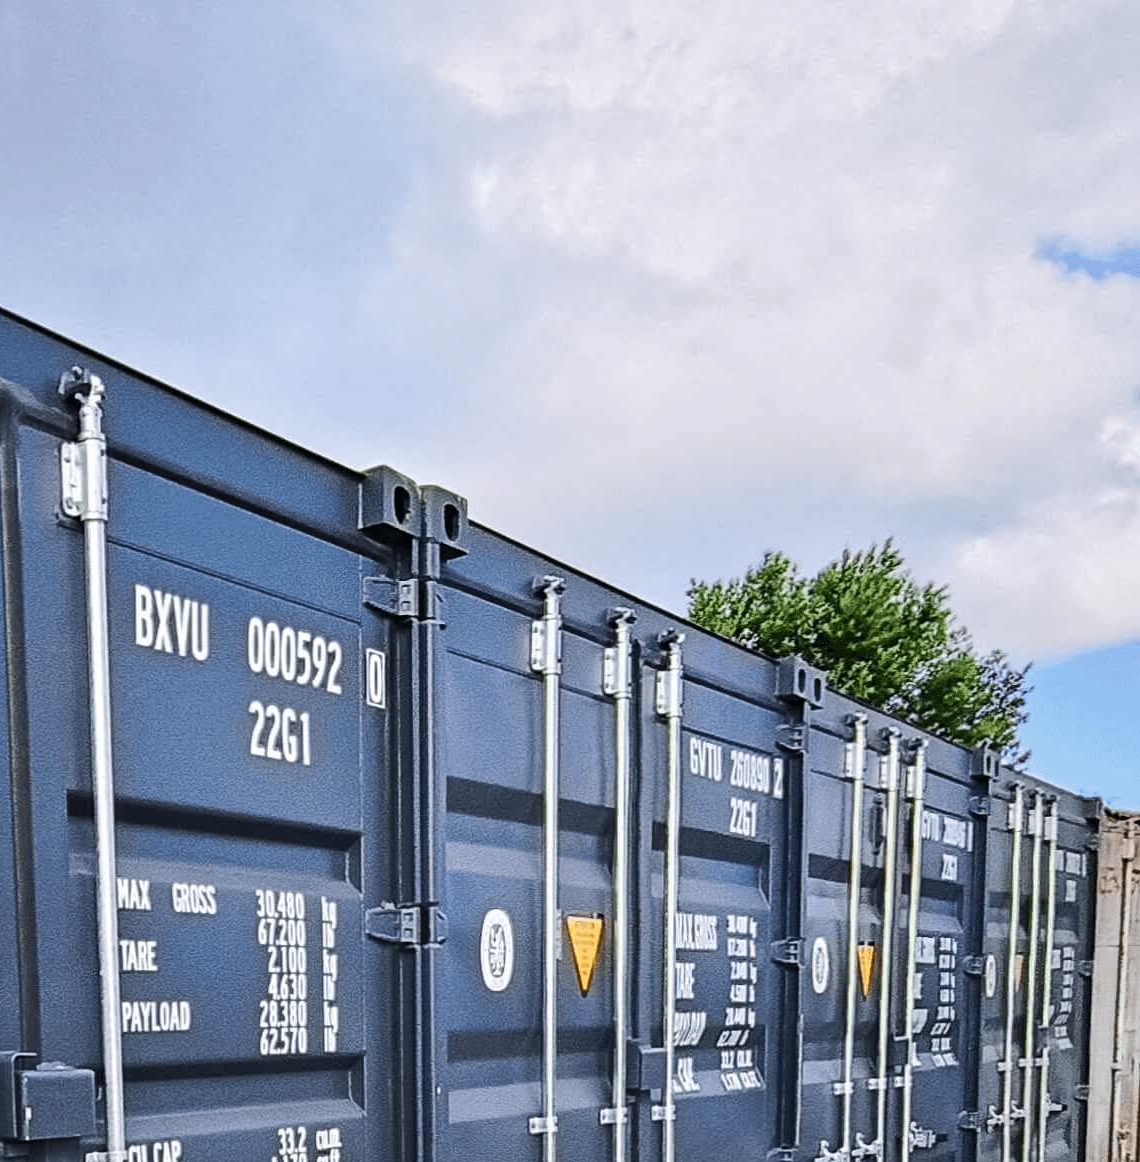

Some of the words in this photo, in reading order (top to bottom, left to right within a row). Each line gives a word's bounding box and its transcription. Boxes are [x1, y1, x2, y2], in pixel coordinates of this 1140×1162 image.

[135, 584, 209, 661] BXVU
[248, 617, 342, 695] 000592
[249, 701, 310, 766] 22G1
[117, 878, 152, 911] MAX
[172, 882, 218, 915] GROSS
[255, 889, 306, 919] 30.480
[321, 896, 338, 929] kg
[257, 918, 307, 947] 67.200
[322, 921, 337, 949] lb
[119, 940, 159, 971] TARE
[267, 946, 308, 974] 2.100
[322, 949, 339, 982] kg
[267, 973, 308, 1000] 4.630
[121, 1001, 191, 1033] PAYLOAD
[259, 1000, 308, 1028] 28.380
[323, 1001, 340, 1033] kg
[260, 1027, 308, 1056] 62.570
[277, 1126, 307, 1155] 33.2
